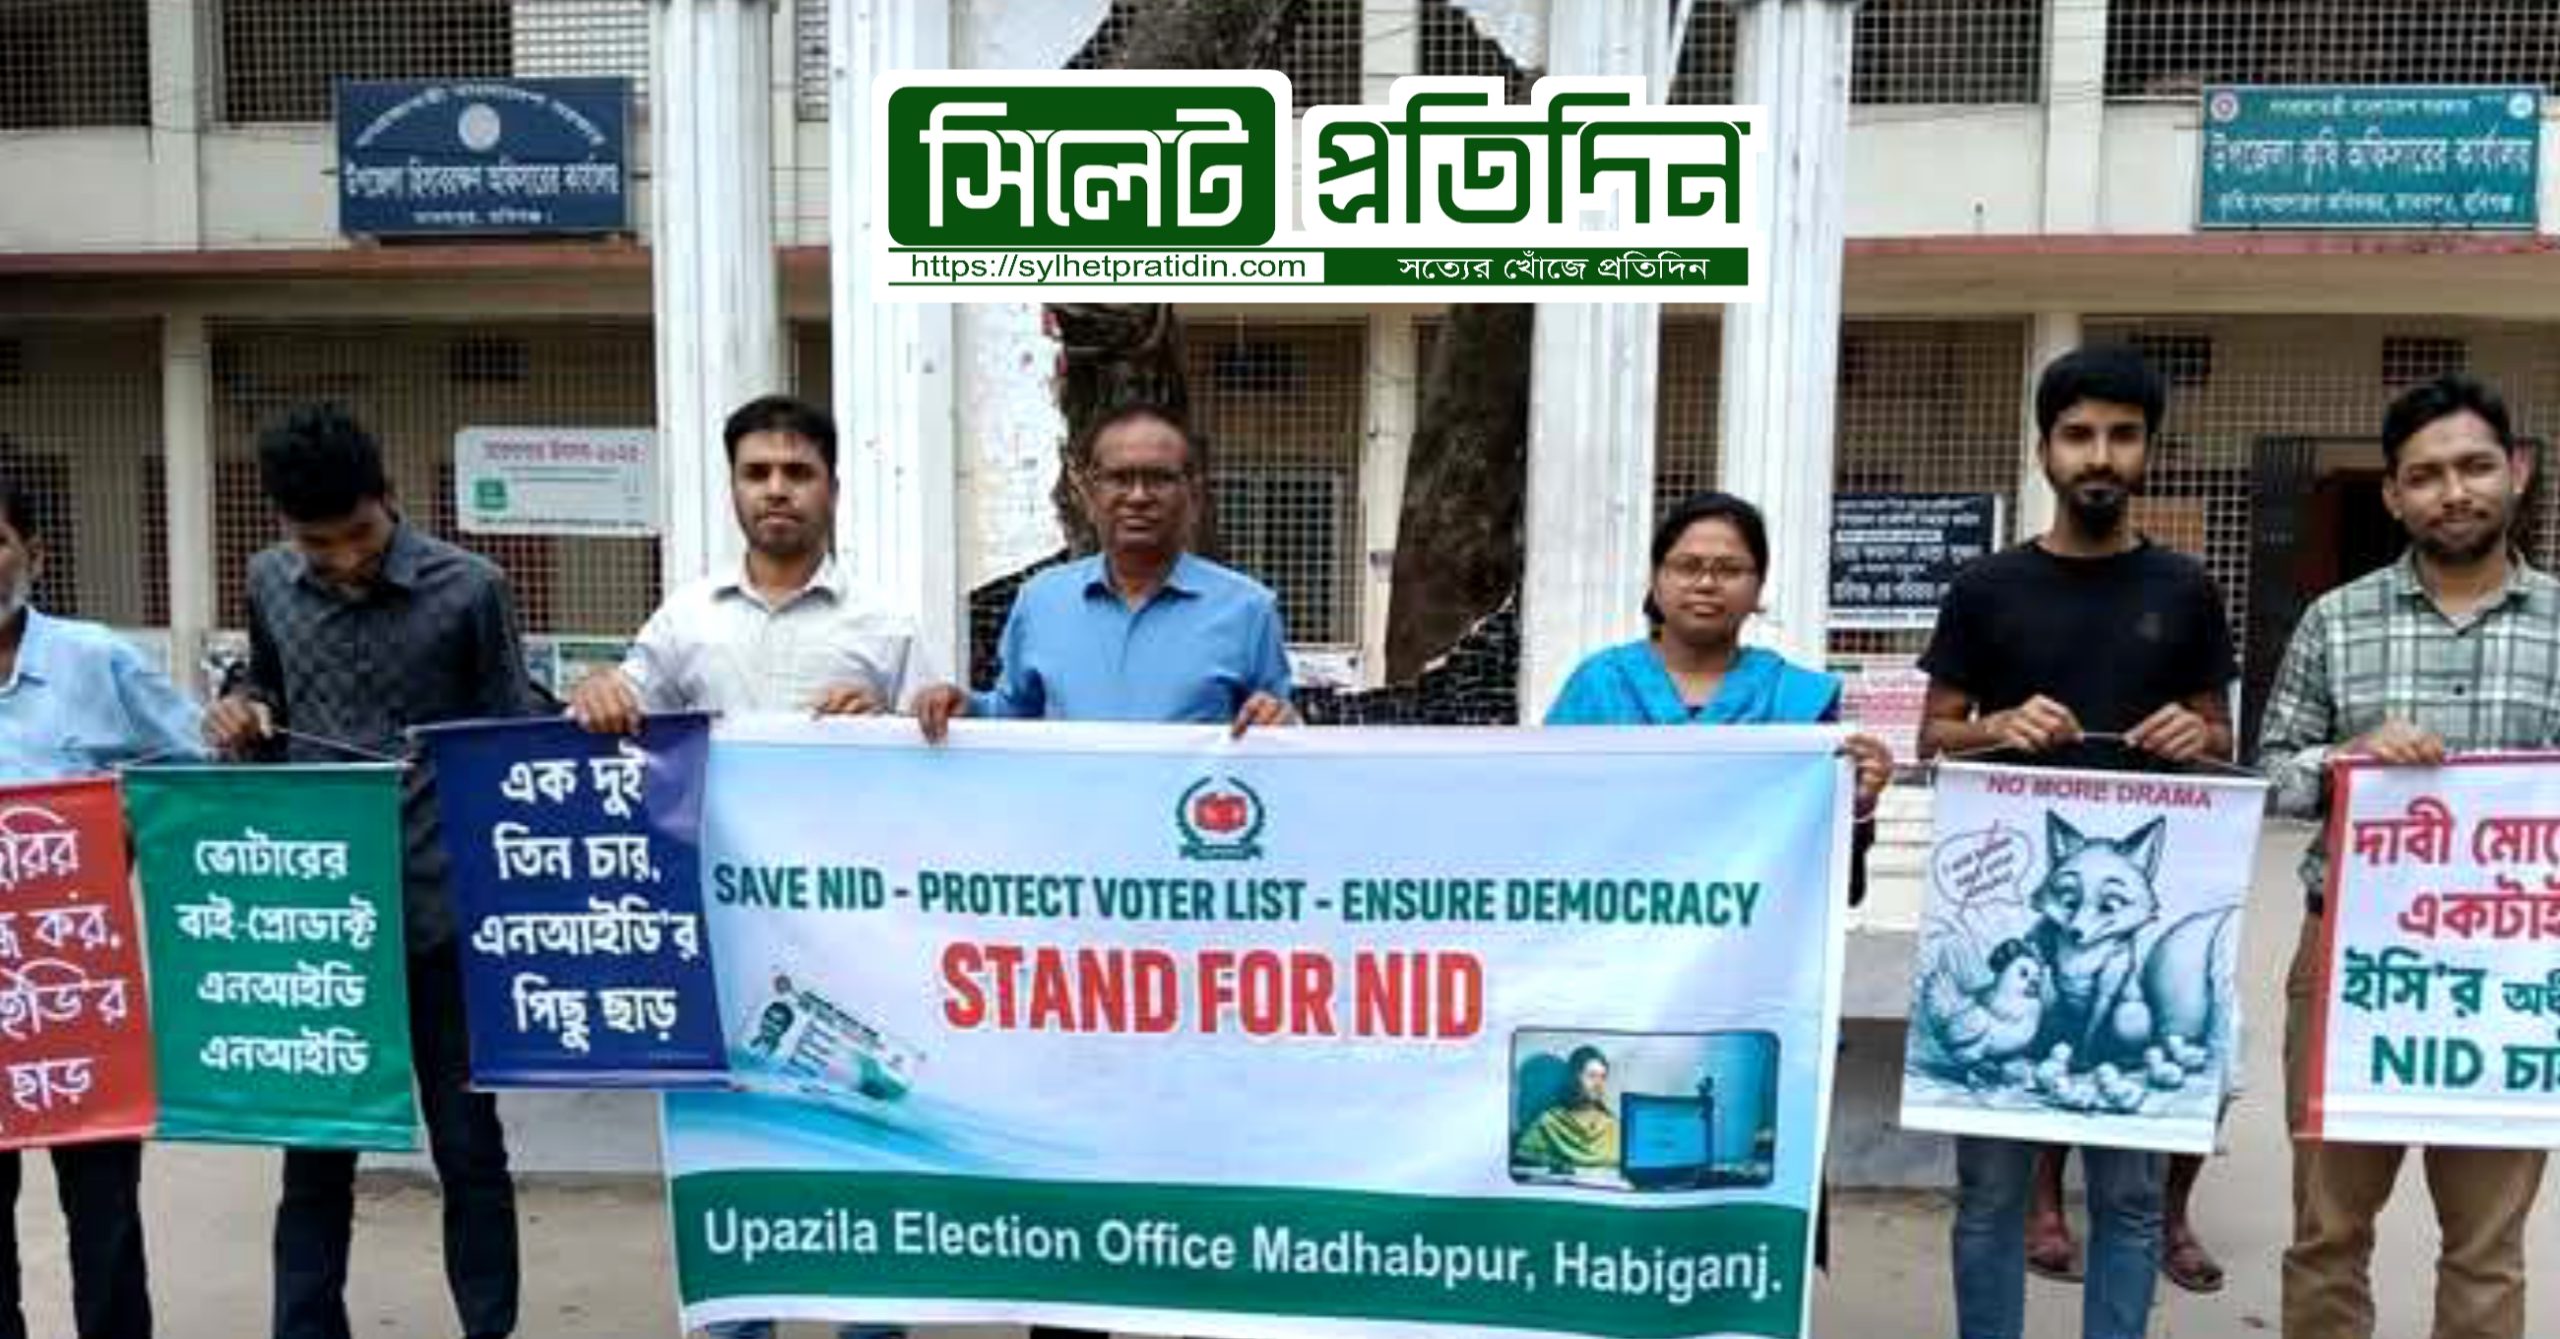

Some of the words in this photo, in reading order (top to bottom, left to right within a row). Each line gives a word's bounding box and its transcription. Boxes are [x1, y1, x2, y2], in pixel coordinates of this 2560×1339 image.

[2211, 132, 2294, 175] উপজেলা
[2300, 125, 2340, 185] কৃষি
[2345, 125, 2449, 174] অফিসারের
[501, 759, 577, 803] এক
[589, 741, 647, 819] দুই
[1987, 774, 2024, 794] NO
[2033, 775, 2108, 801] MORE
[2116, 781, 2211, 809] DRAMA
[195, 826, 348, 880] ভোটারের
[493, 821, 572, 880] তিন
[2352, 796, 2454, 866] দাবী
[713, 863, 807, 910] SAVE
[818, 868, 884, 910] NID
[918, 871, 1084, 919] PROTECT
[1092, 876, 1215, 921] VOTER
[1226, 879, 1307, 922] LIST
[1342, 879, 1496, 922] ENSURE
[1506, 879, 1760, 927] DEMOCRACY
[197, 960, 367, 1009] এনআইডি
[512, 972, 590, 1052] পিছু
[597, 988, 677, 1041] ছাড়
[943, 942, 1177, 1032] STAND
[1198, 950, 1335, 1036] FOR
[1354, 951, 1483, 1040] NID
[200, 1025, 370, 1075] এনআইডি
[2370, 1034, 2484, 1088] NID
[2503, 1028, 2560, 1092] চা
[6, 1057, 93, 1112] ছাড়
[704, 1208, 879, 1262] Upazila
[893, 1210, 1081, 1260] Election
[1096, 1219, 1237, 1269] Office
[1252, 1225, 1536, 1290] Madhabpur,
[1554, 1240, 1783, 1304] Habiganj.
